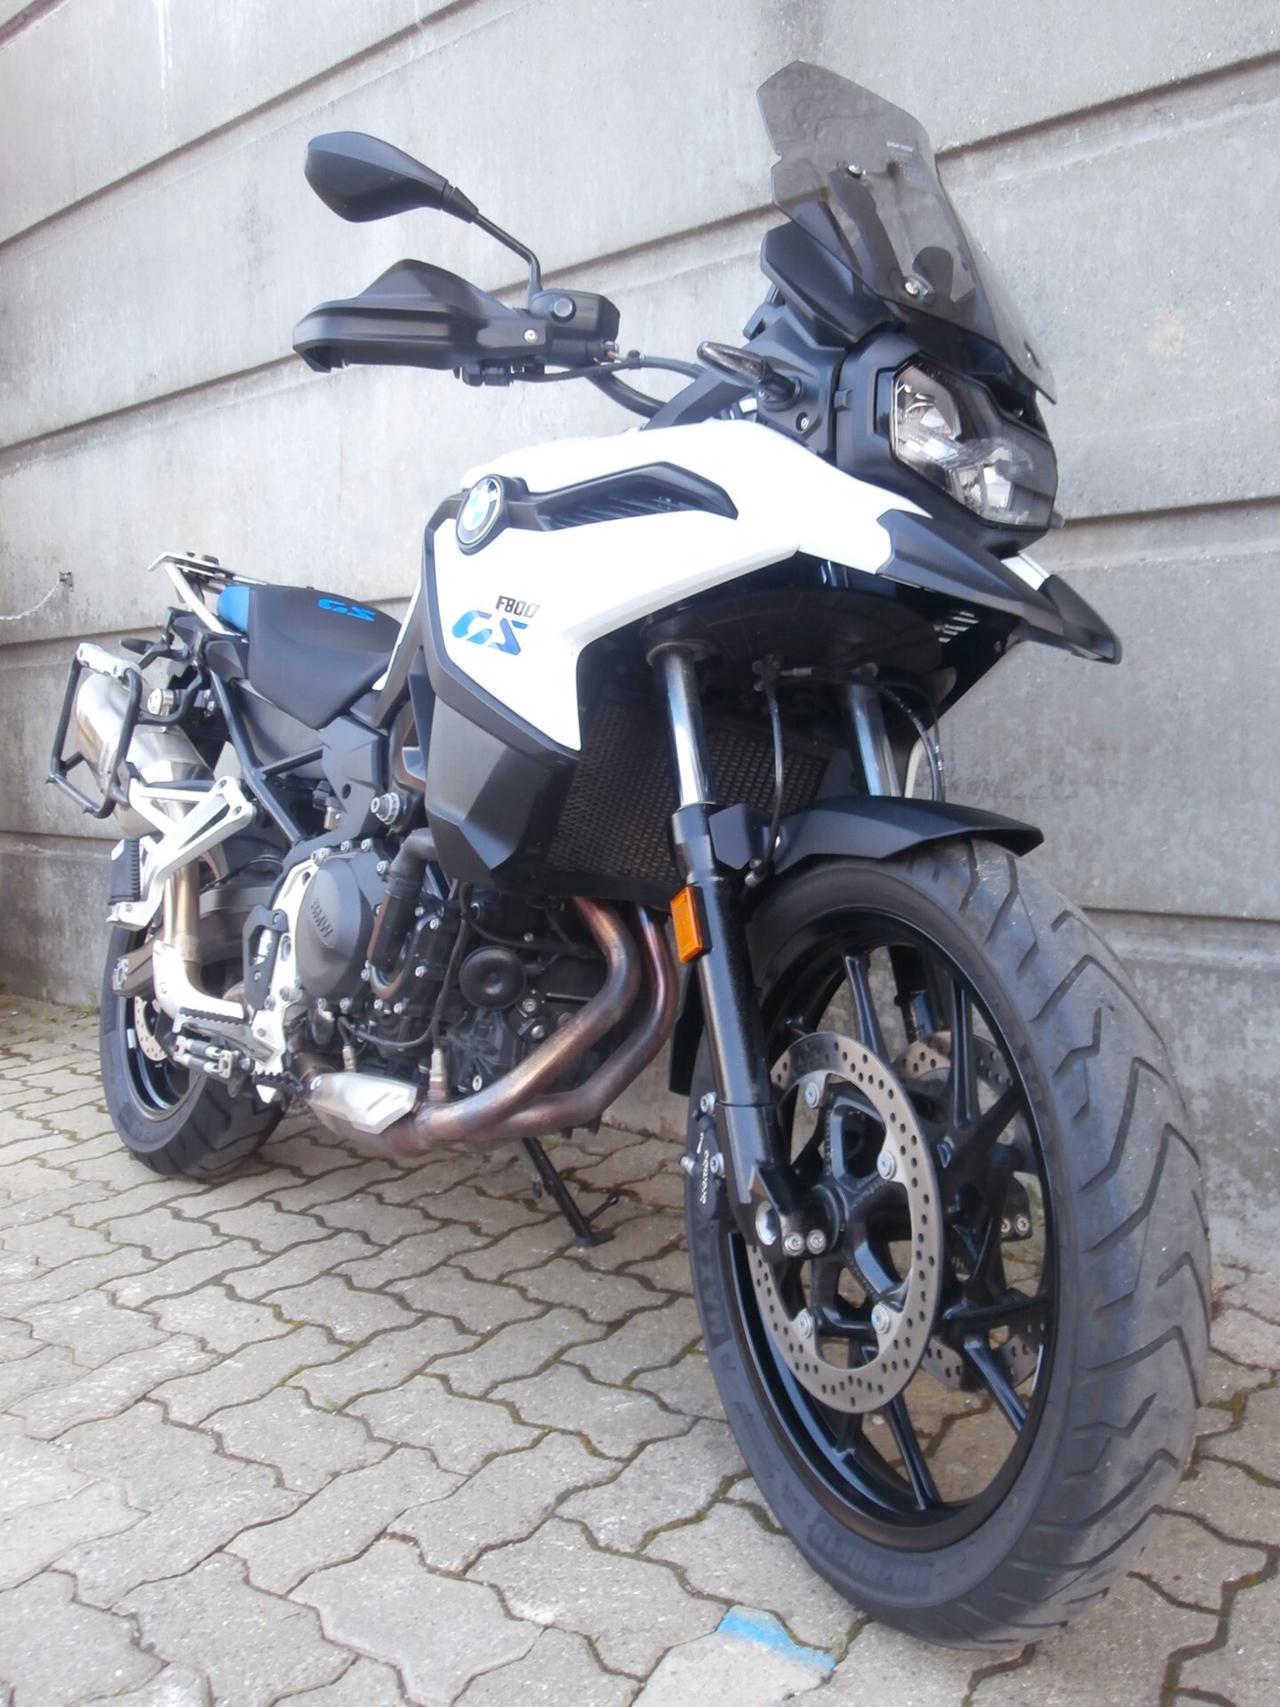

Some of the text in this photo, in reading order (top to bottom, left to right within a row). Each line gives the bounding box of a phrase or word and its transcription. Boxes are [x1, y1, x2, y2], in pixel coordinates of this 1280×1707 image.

[318, 598, 375, 621] GS
[496, 595, 541, 619] F800
[451, 609, 529, 656] GS
